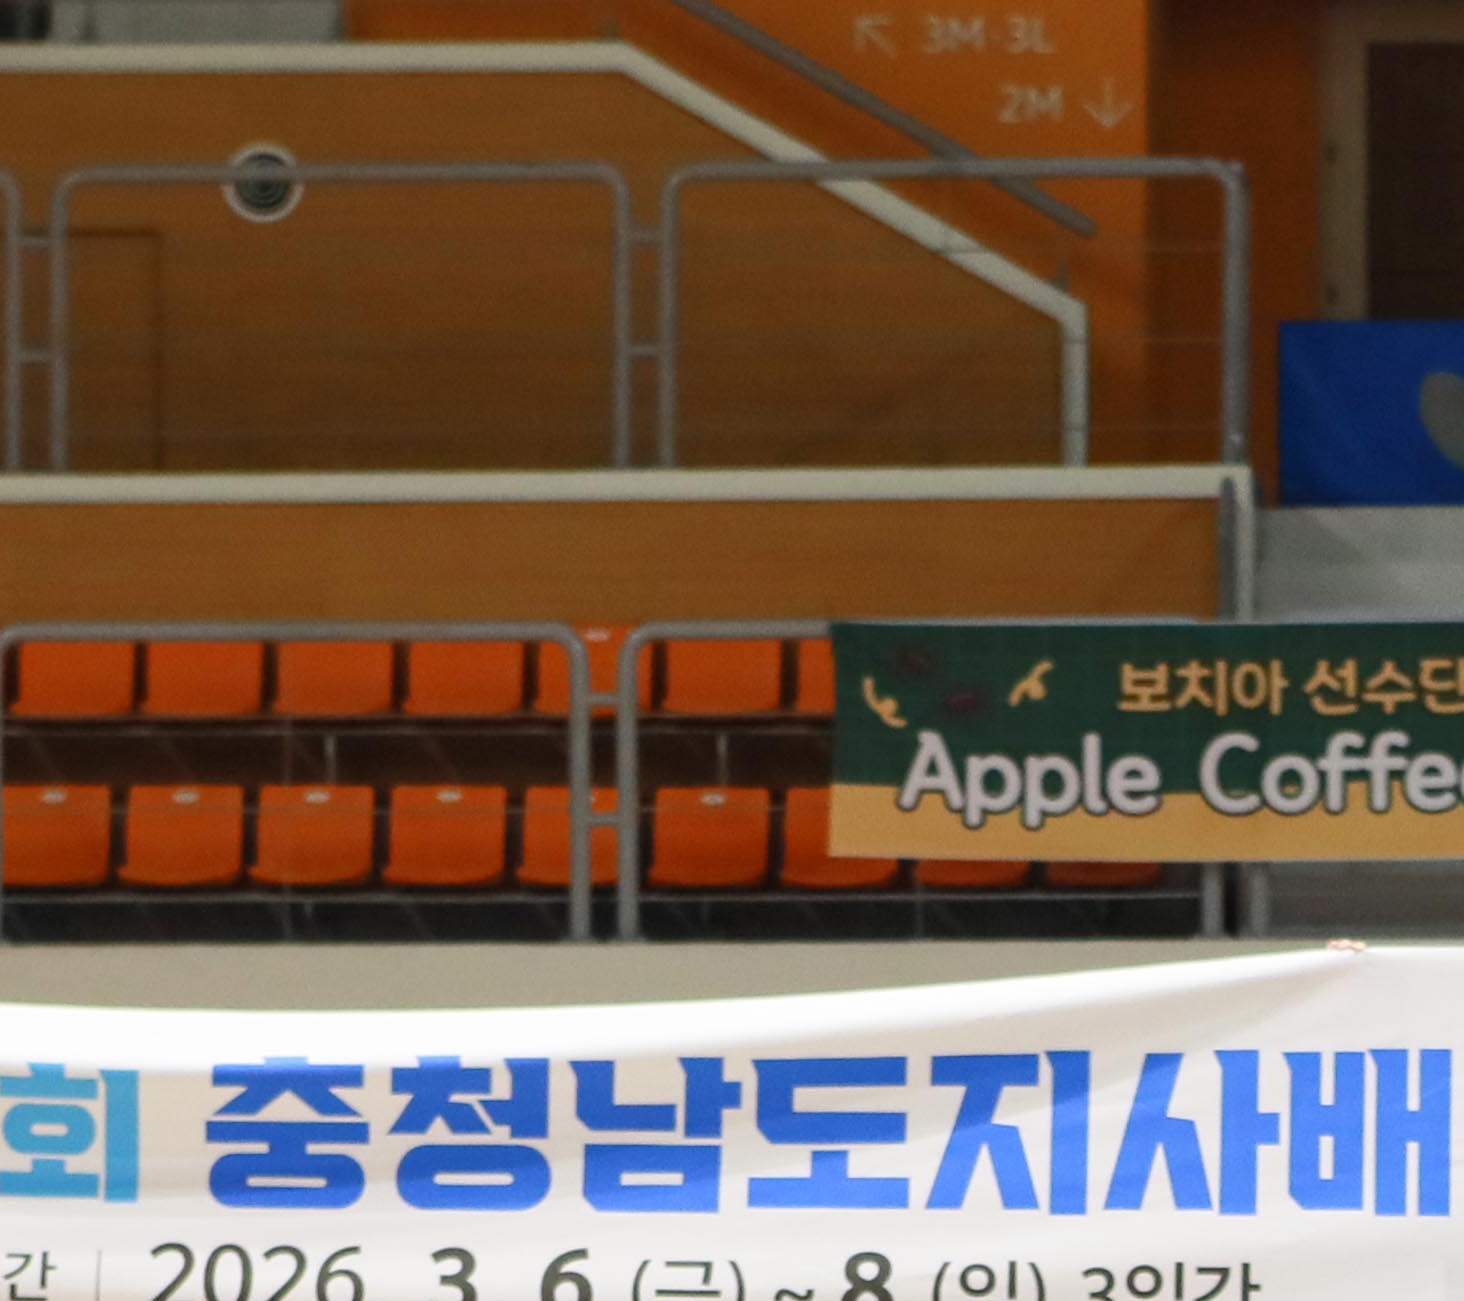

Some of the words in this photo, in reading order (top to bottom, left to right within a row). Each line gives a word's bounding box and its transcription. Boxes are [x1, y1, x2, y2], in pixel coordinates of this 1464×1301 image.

[1116, 657, 1291, 717] 보치아
[895, 729, 1163, 829] Apple
[205, 1049, 1452, 1215] 충청남도지사배
